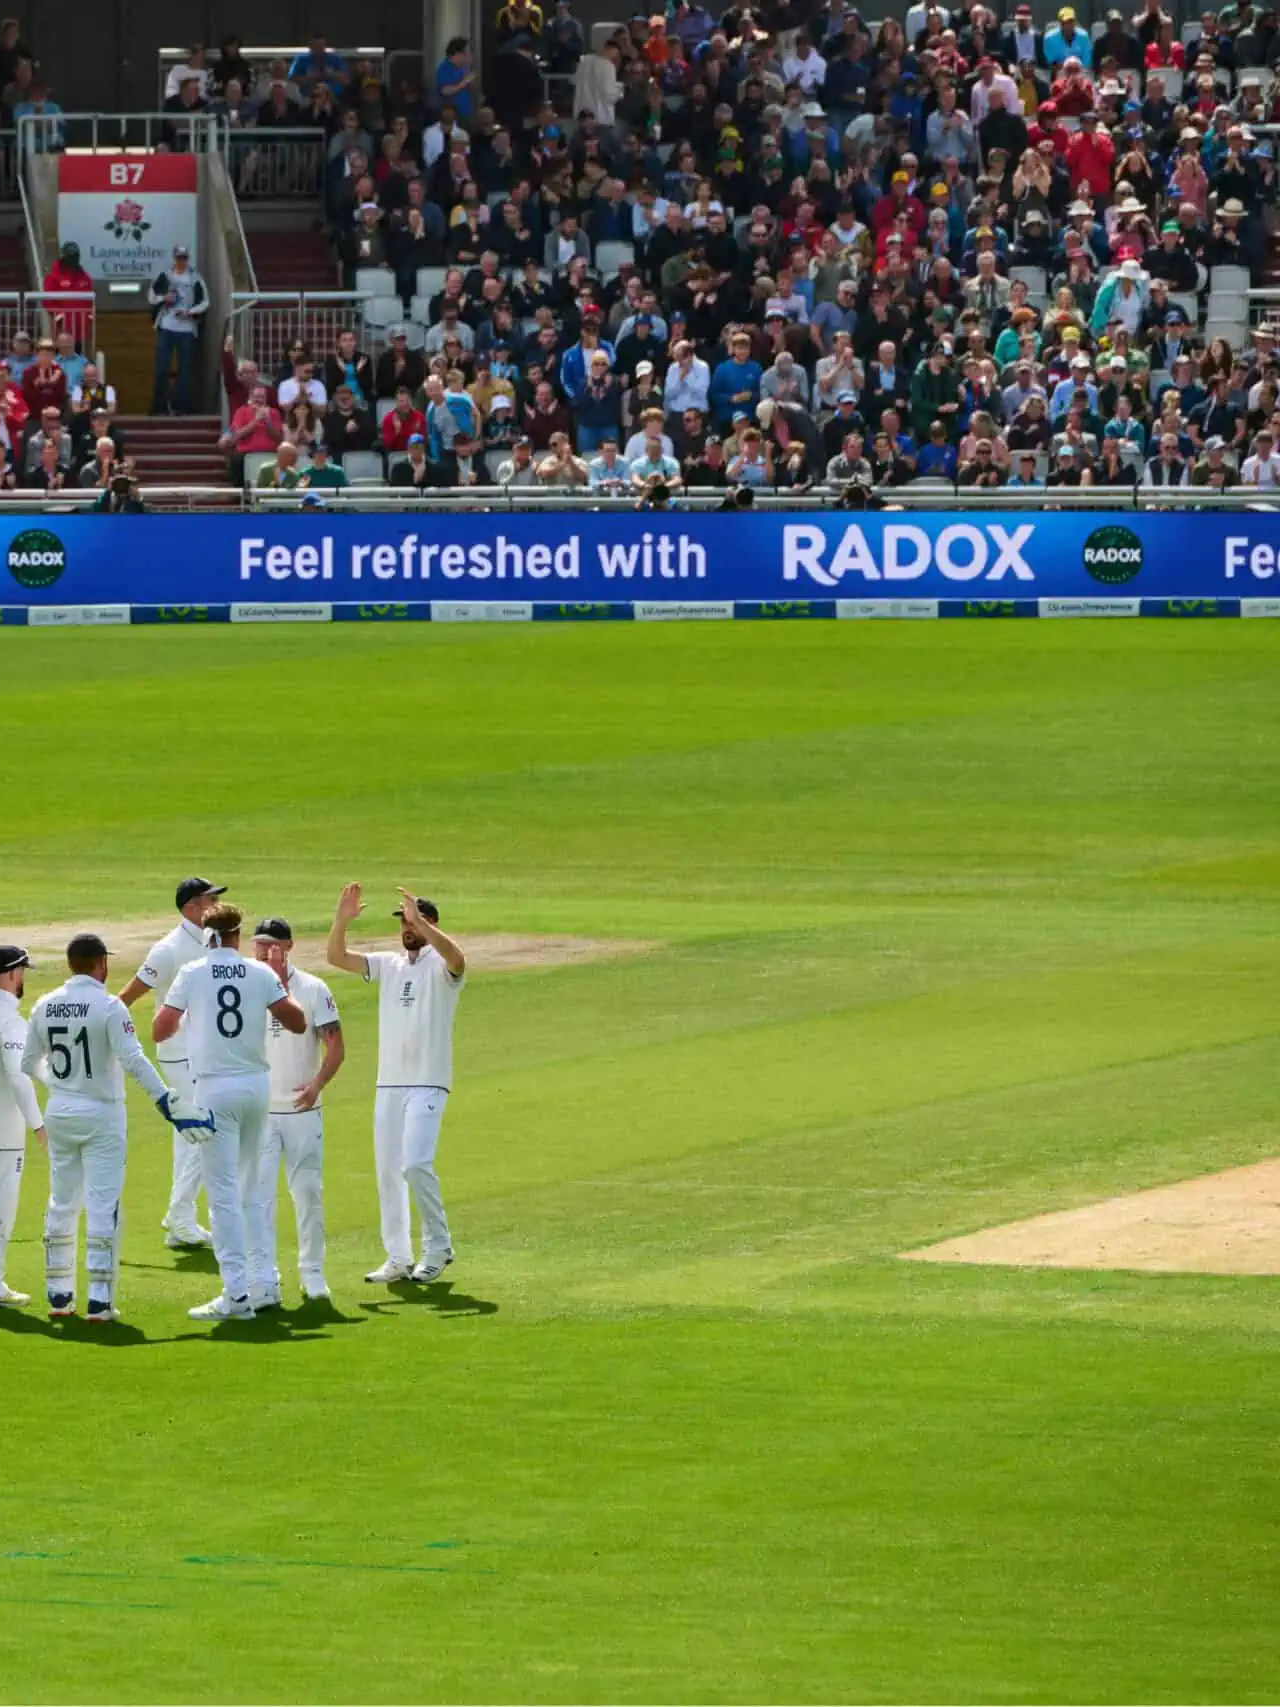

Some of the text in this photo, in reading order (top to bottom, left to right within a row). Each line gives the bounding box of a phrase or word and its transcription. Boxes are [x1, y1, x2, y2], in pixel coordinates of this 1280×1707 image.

[109, 163, 145, 185] B7
[89, 245, 166, 258] Lancashire
[101, 260, 152, 273] Cricket
[7, 551, 65, 567] RADOX
[240, 533, 706, 580] Feel refreshed with
[783, 523, 1036, 586] RADOX
[1084, 547, 1142, 564] RADOX
[1225, 537, 1280, 578] Fe
[211, 963, 246, 979] BROAD
[45, 1003, 90, 1018] BAIRSTOW
[216, 984, 244, 1039] 8
[47, 1026, 92, 1080] 51
